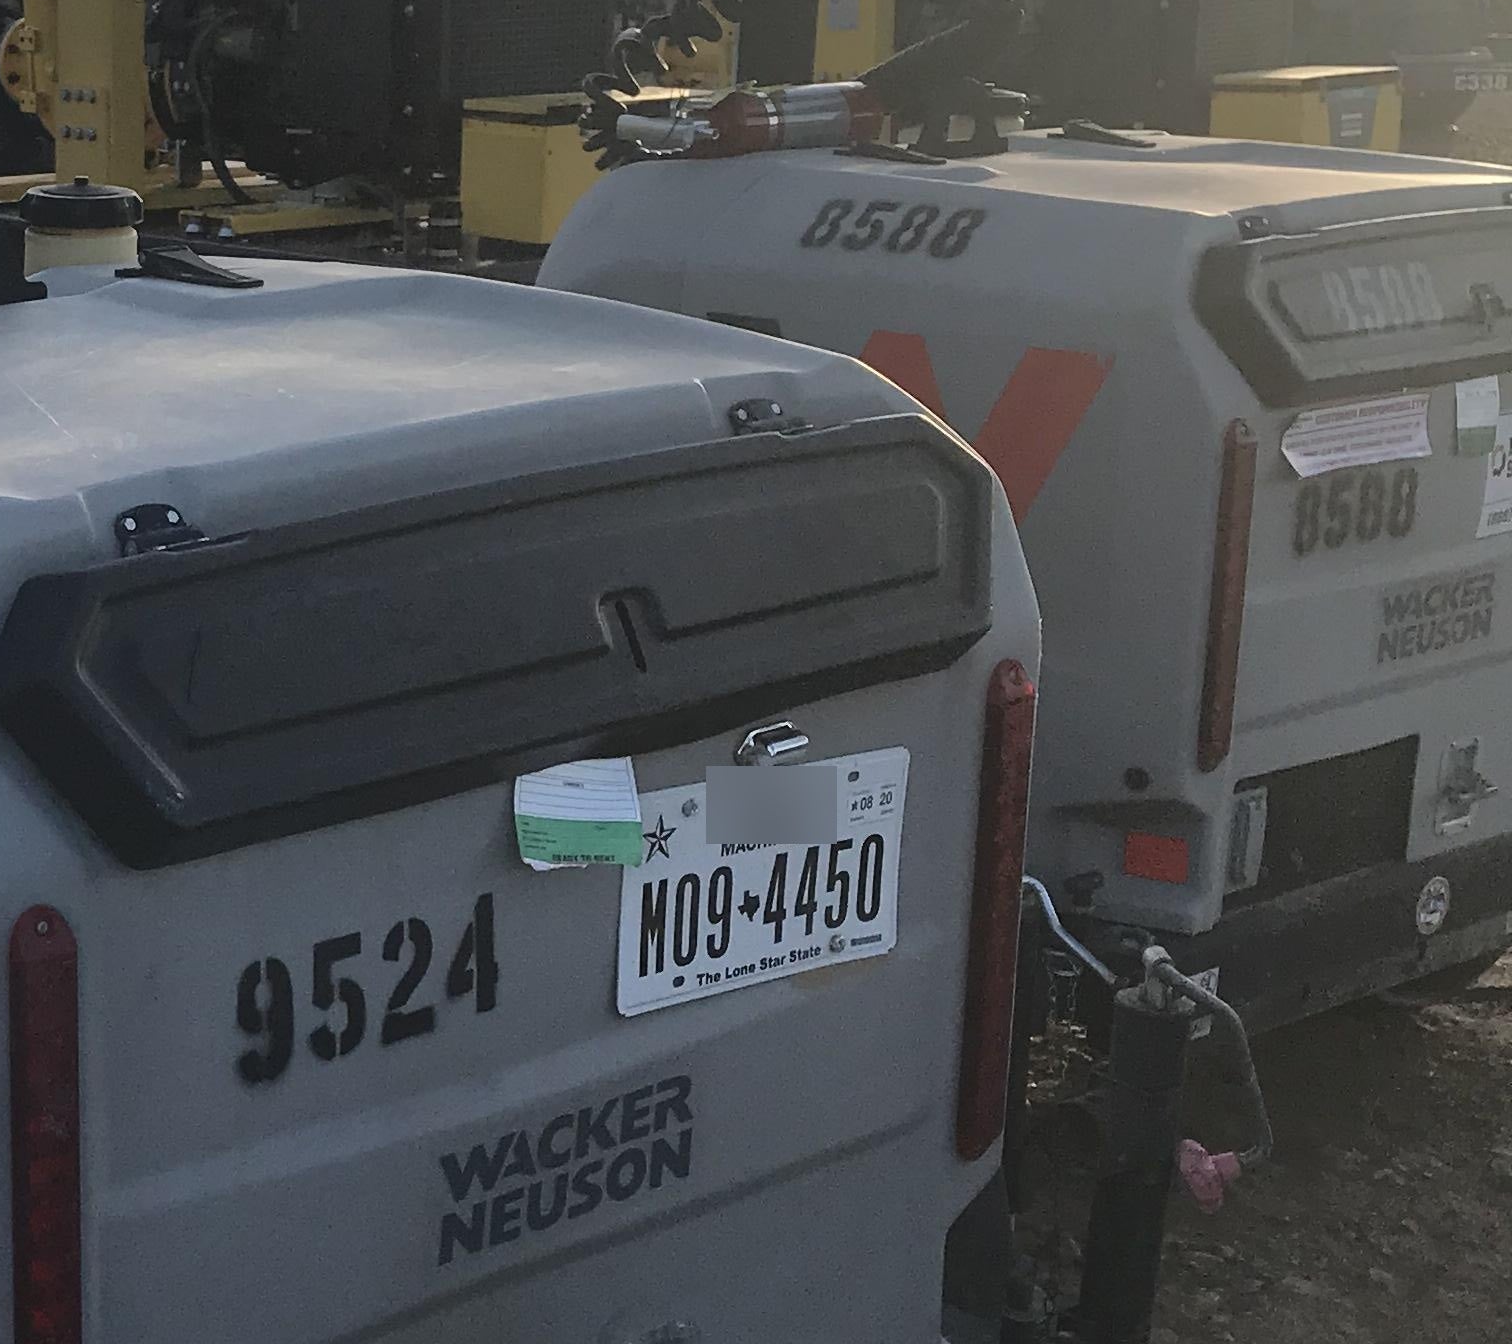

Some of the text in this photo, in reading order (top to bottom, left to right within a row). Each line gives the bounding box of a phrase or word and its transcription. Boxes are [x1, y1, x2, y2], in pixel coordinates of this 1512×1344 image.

[800, 198, 986, 258] 8588
[1293, 467, 1419, 555] 8588
[1384, 570, 1495, 626] WACKER
[1377, 608, 1493, 665] NEUSON
[860, 791, 893, 811] 08 20
[237, 892, 499, 1085] 9524
[696, 945, 822, 987] The Lone Star State
[437, 1074, 694, 1203] WACKER
[438, 1127, 693, 1267] NEUSON
